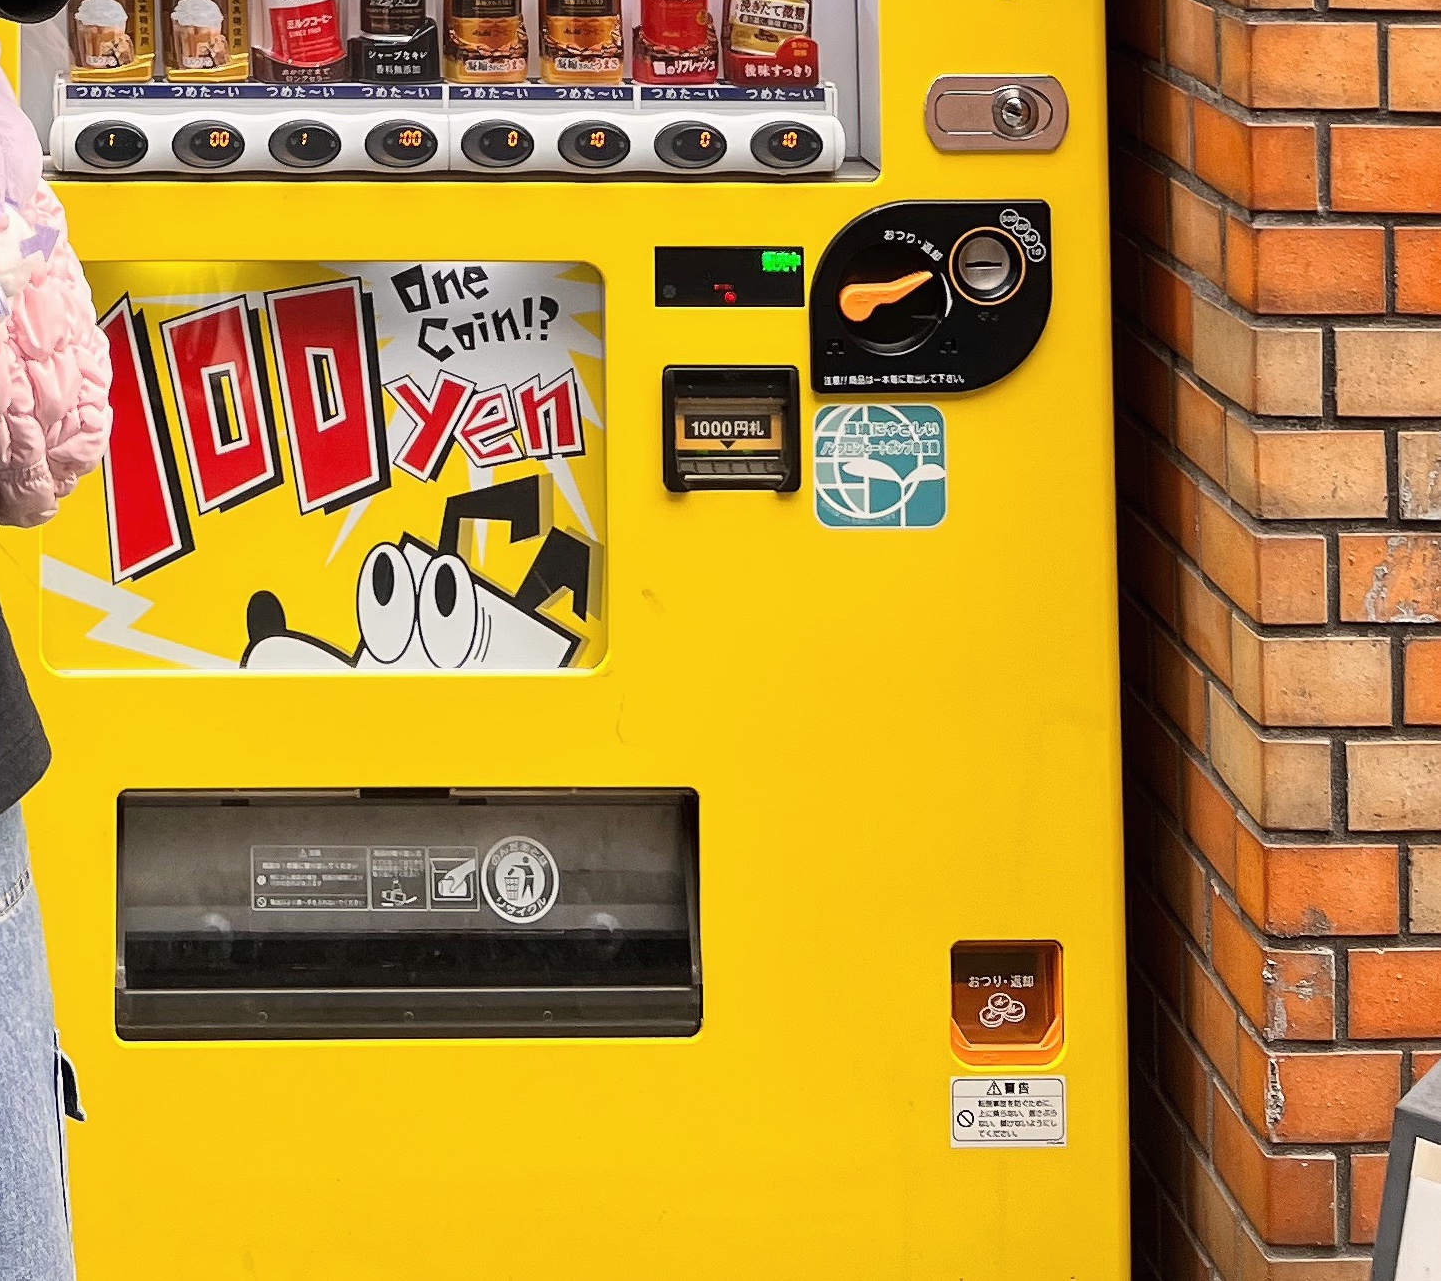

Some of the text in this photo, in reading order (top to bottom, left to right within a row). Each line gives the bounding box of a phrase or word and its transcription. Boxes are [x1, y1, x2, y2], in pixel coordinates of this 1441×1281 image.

[287, 15, 333, 29] ミルクコーヒー
[391, 264, 489, 314] One
[418, 296, 559, 362] Coin!?
[98, 276, 391, 584] 100
[691, 420, 764, 436] 1000円札
[495, 896, 548, 917] リサイクル
[968, 975, 1035, 987] おつり・返却
